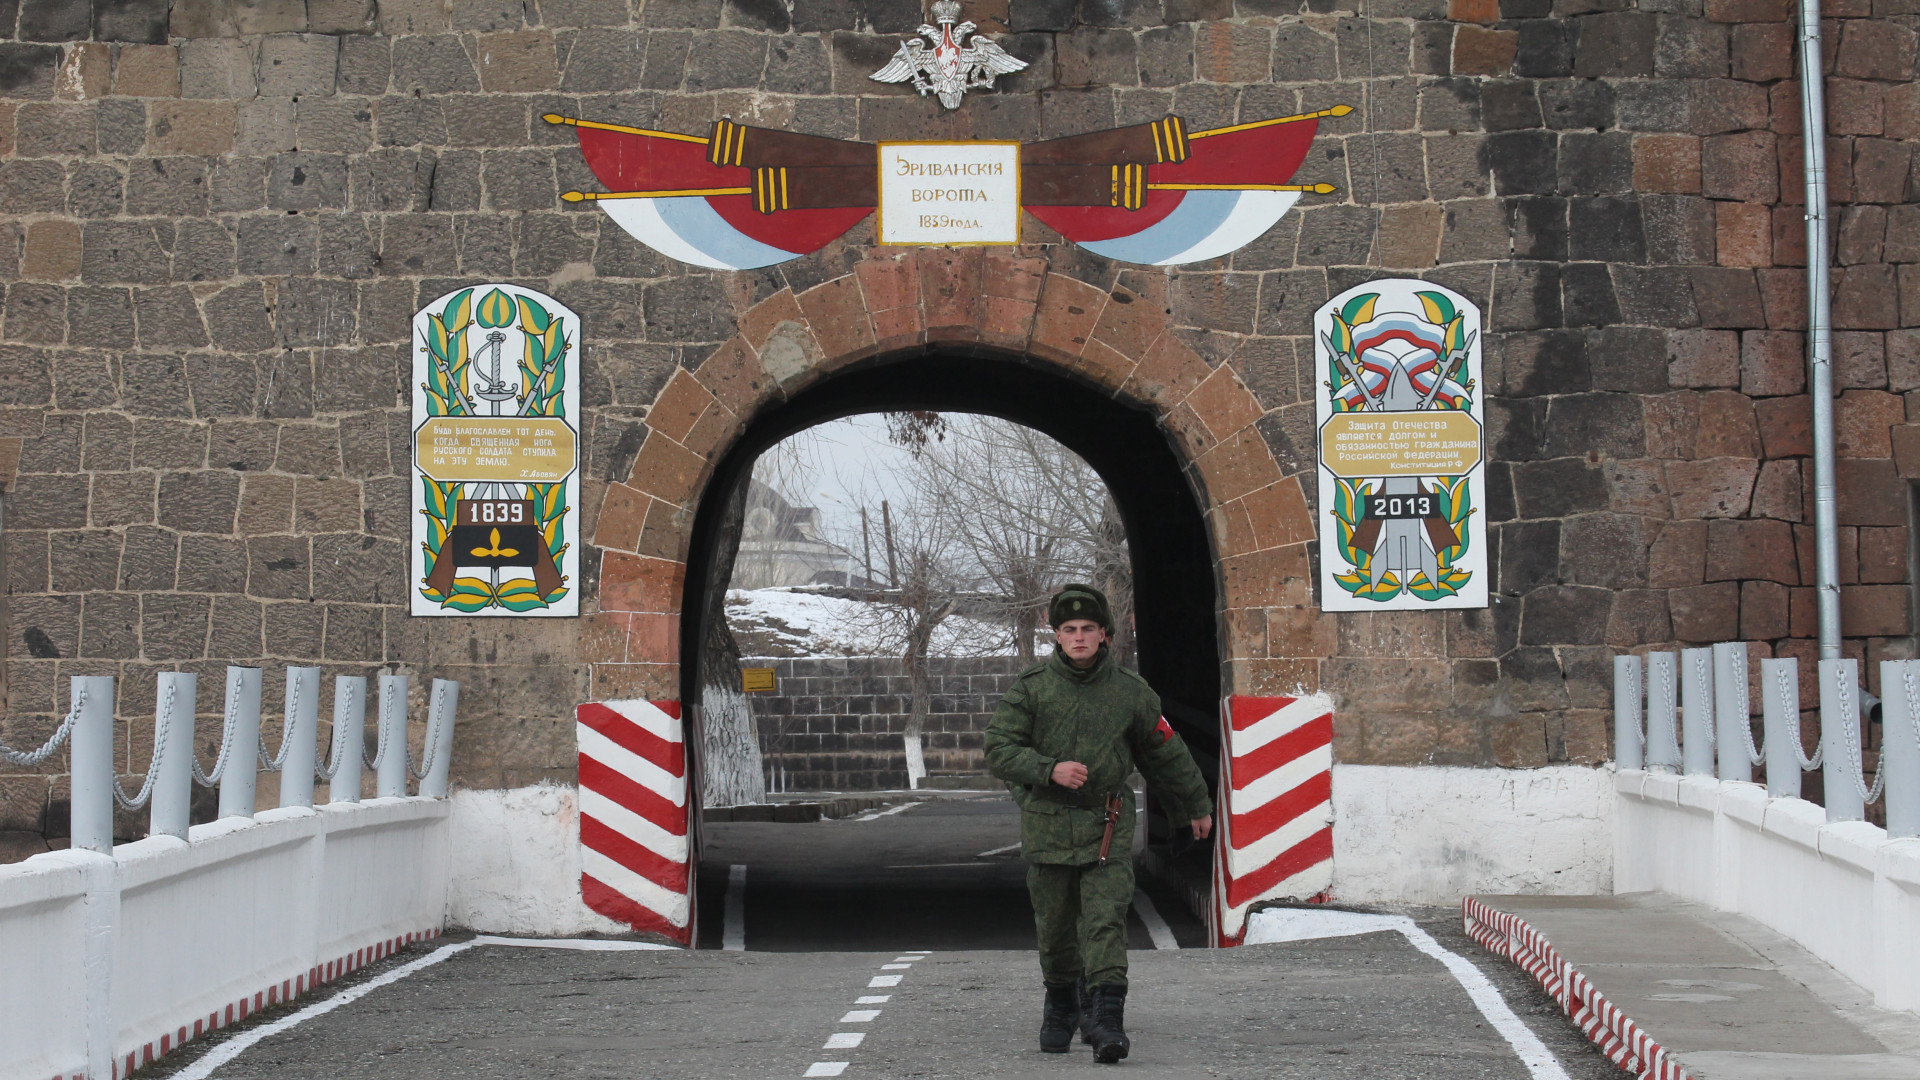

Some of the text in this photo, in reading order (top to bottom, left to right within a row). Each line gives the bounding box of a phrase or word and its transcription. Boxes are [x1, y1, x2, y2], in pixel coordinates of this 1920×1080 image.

[912, 189, 987, 202] ВОРОТА
[1348, 420, 1447, 430] Защита Отечества
[1336, 432, 1382, 440] является
[1389, 432, 1426, 440] долгом
[434, 438, 459, 446] КОГДА
[470, 438, 520, 447] СВЯЩЕННАЯ
[1336, 442, 1410, 450] обязанностью
[434, 447, 472, 455] РУССКОГО
[523, 448, 556, 456] СТУПИЛА
[476, 458, 510, 466] ЗЕМЛЮ.
[1374, 498, 1430, 516] 2013
[470, 503, 522, 522] 1839
